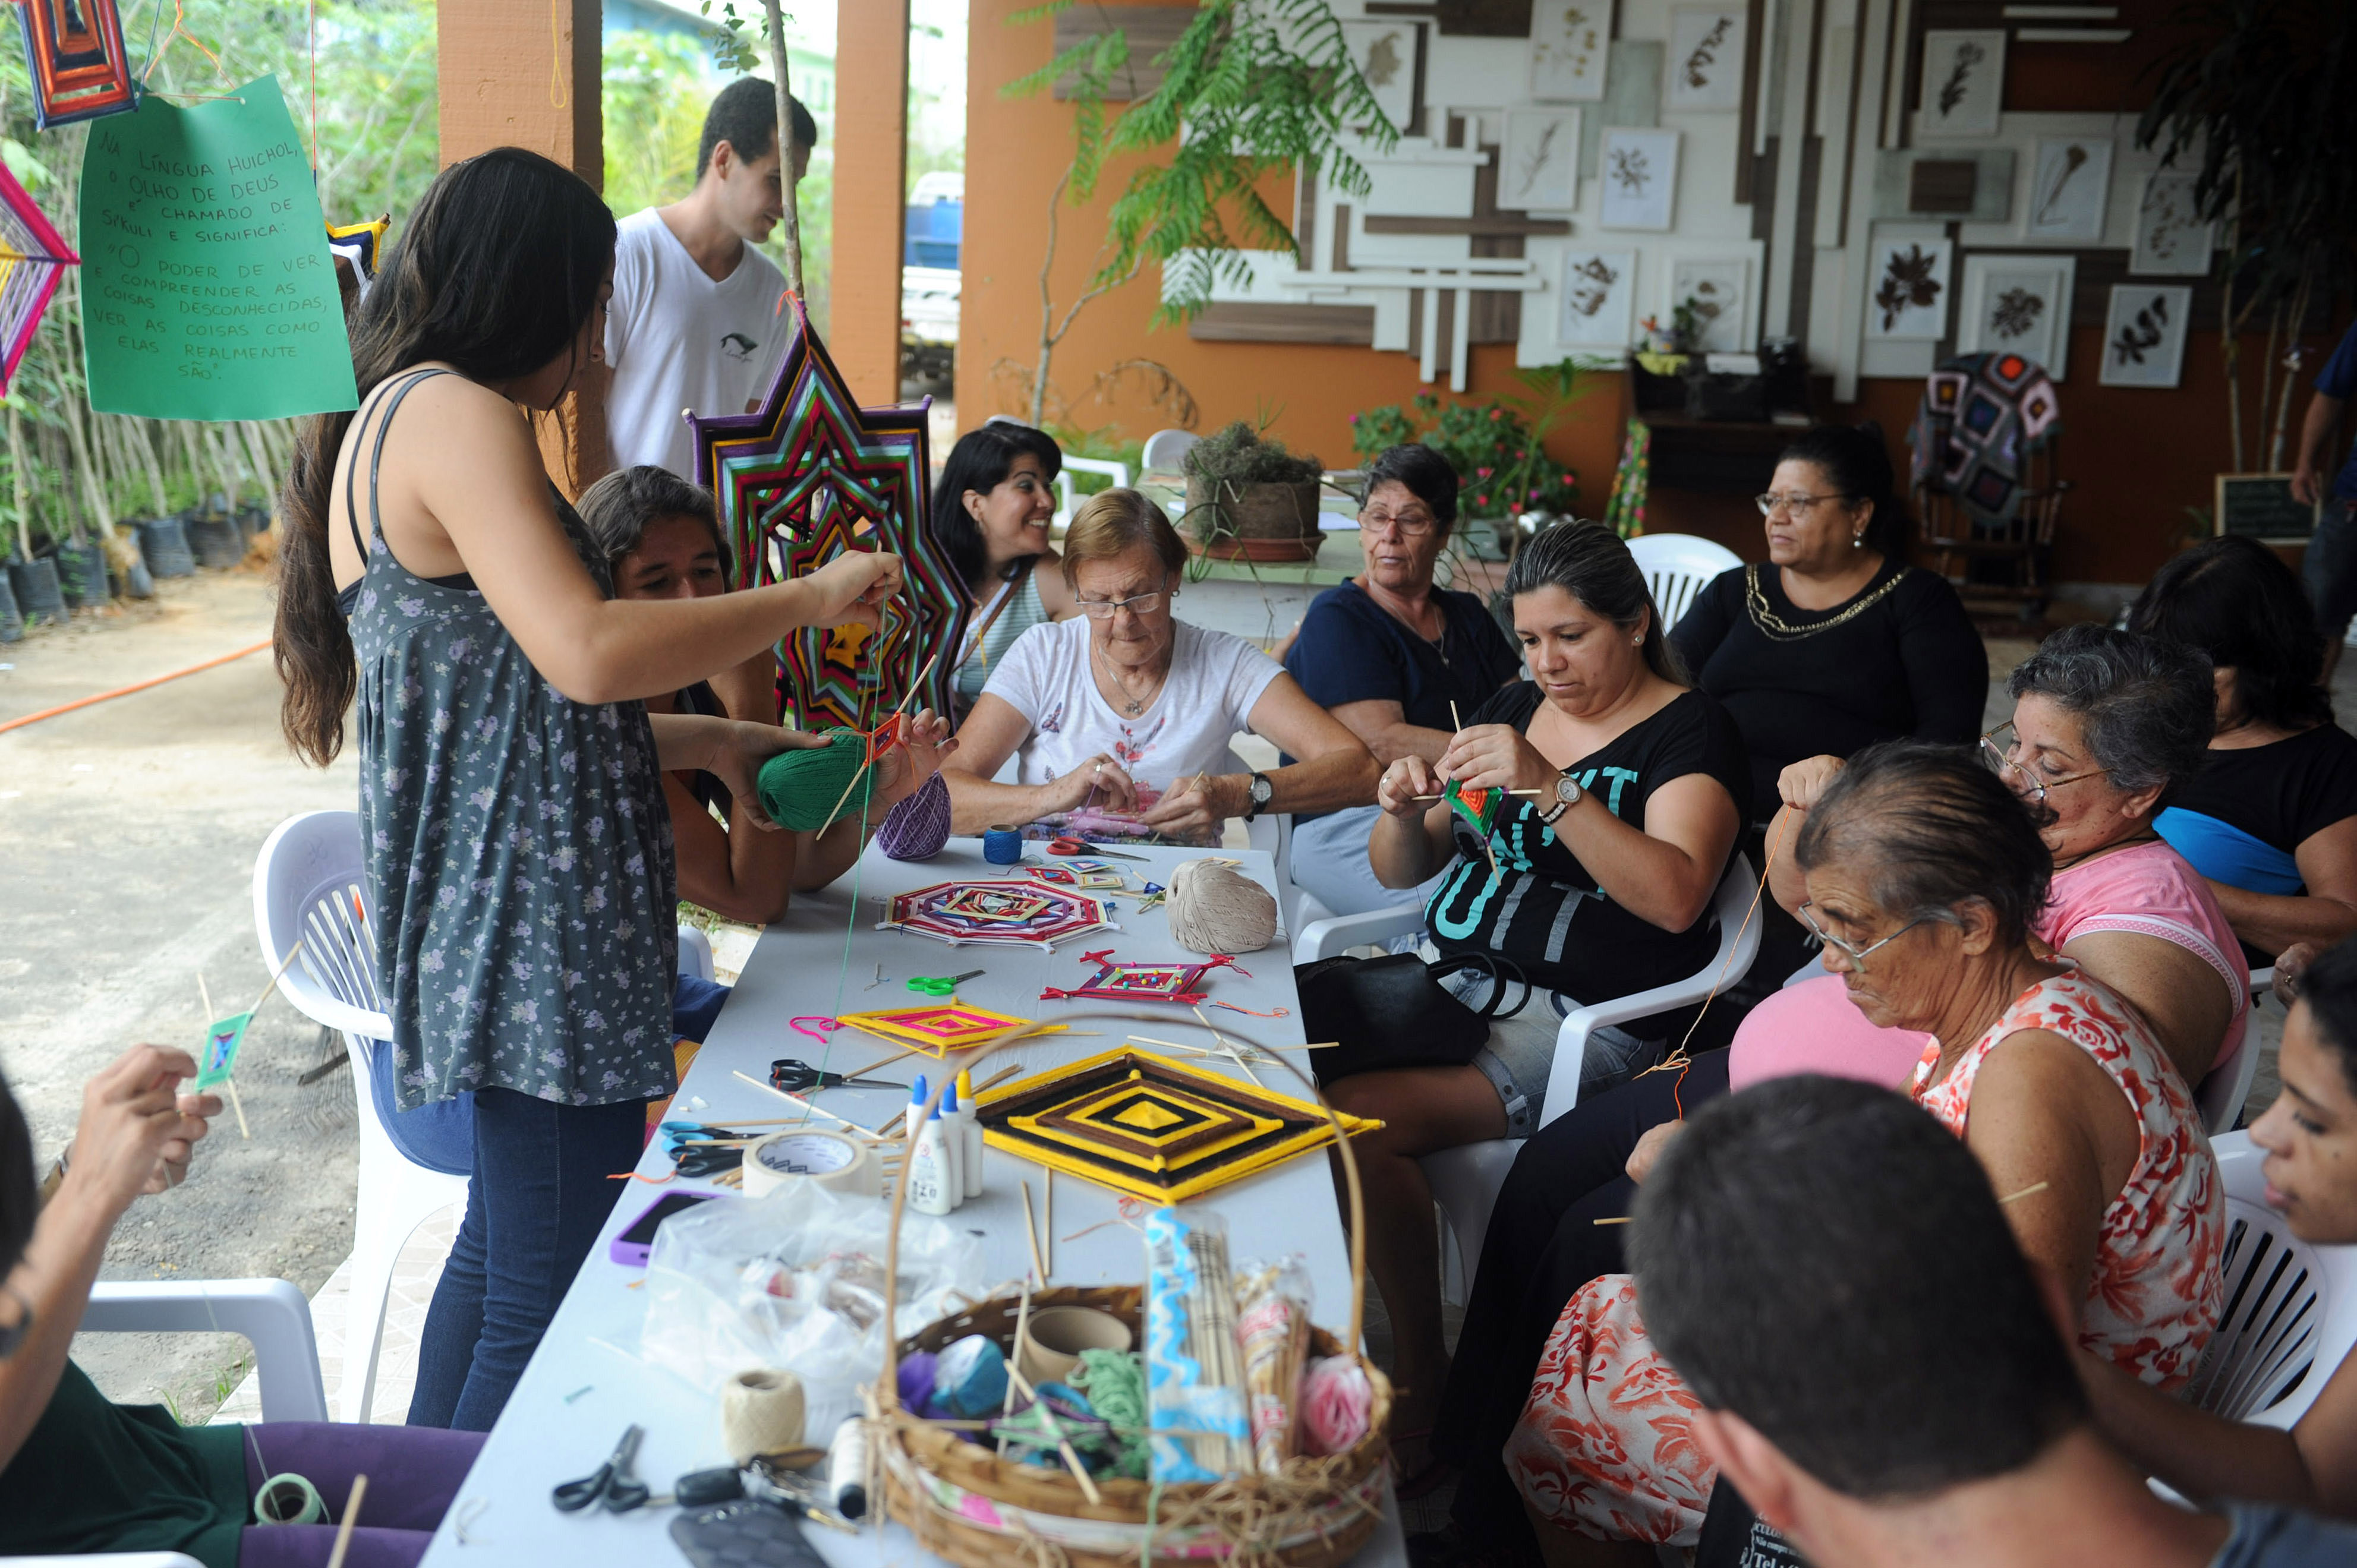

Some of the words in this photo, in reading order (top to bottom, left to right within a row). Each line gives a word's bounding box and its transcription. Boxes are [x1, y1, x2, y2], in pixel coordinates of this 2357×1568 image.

[99, 131, 119, 155] NA
[138, 150, 214, 177] LÍNGUA
[228, 141, 298, 175] HUICHOL,
[129, 175, 179, 200] OLHO
[192, 187, 218, 203] DE
[231, 173, 279, 200] DEUS
[161, 206, 253, 221] CHAMADO
[270, 198, 293, 214] DE
[169, 230, 179, 242] E
[195, 223, 287, 242] SIGNIFICA:
[158, 260, 219, 279] PODER
[238, 264, 265, 279] DE
[282, 254, 320, 272] VER
[94, 267, 102, 279] E
[121, 273, 260, 297] COMPREENDER
[275, 282, 297, 295] AS
[103, 285, 156, 310] COISAS
[93, 307, 129, 327] VER
[145, 318, 166, 333] AS
[186, 324, 249, 337] COISAS
[266, 321, 320, 335] COMO
[118, 335, 159, 354] ELAS
[184, 343, 297, 360] REALMENTE
